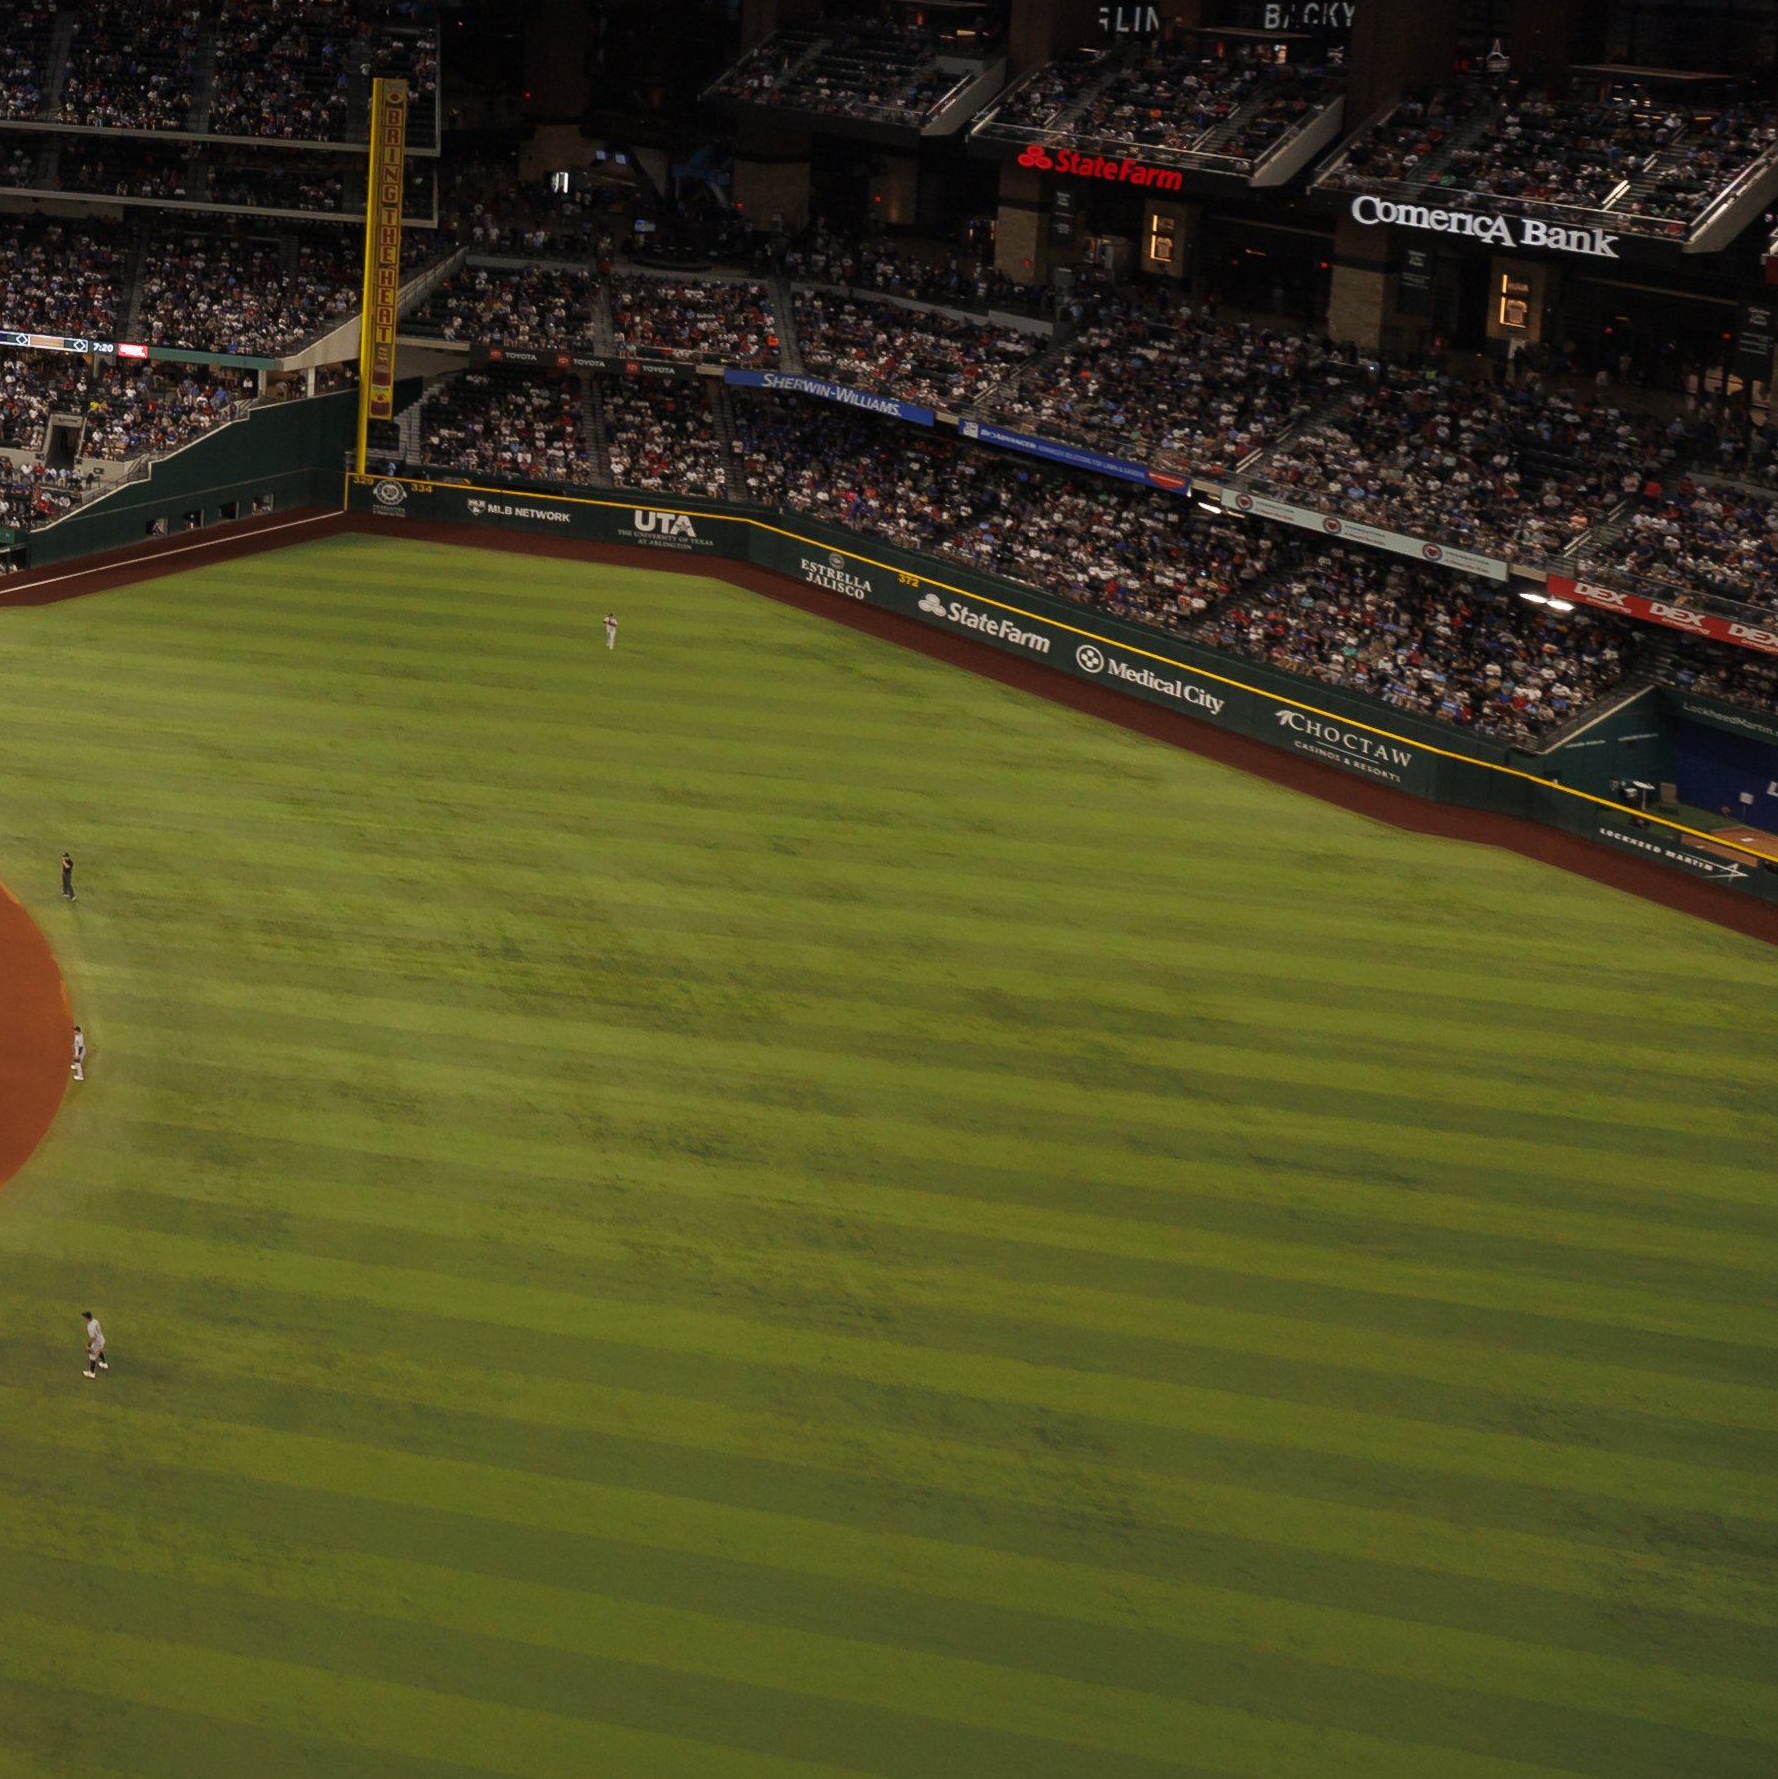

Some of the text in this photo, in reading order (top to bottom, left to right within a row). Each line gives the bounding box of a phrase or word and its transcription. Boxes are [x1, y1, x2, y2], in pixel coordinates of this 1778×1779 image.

[383, 107, 404, 203] BRING
[379, 207, 400, 263] THE
[1521, 219, 1621, 259] Bank
[375, 268, 396, 344] HEAT
[92, 343, 114, 353] 7:20
[505, 351, 537, 362] TOYOTA
[573, 357, 606, 368] TOYOTA
[643, 364, 676, 375] TOYOTA
[353, 475, 374, 486] 329
[411, 482, 433, 493] 334
[488, 503, 572, 523] MLB NETWORK
[634, 510, 697, 538] UTA
[617, 529, 632, 537] THE
[633, 531, 677, 542] UNIVERSITY
[691, 539, 715, 547] TEXAS
[648, 540, 692, 550] ARLINGTON
[800, 558, 872, 593] ESTRELLA
[805, 572, 865, 601] JALISCO
[898, 572, 920, 588] 372
[1573, 582, 1629, 606] DEX
[1649, 601, 1706, 627] DEX
[1290, 712, 1413, 768] CHOCTAW
[1294, 739, 1341, 762] CASINOS
[1353, 760, 1401, 784] RESORTS
[1599, 827, 1714, 872] LOCKHEED MARTIN
